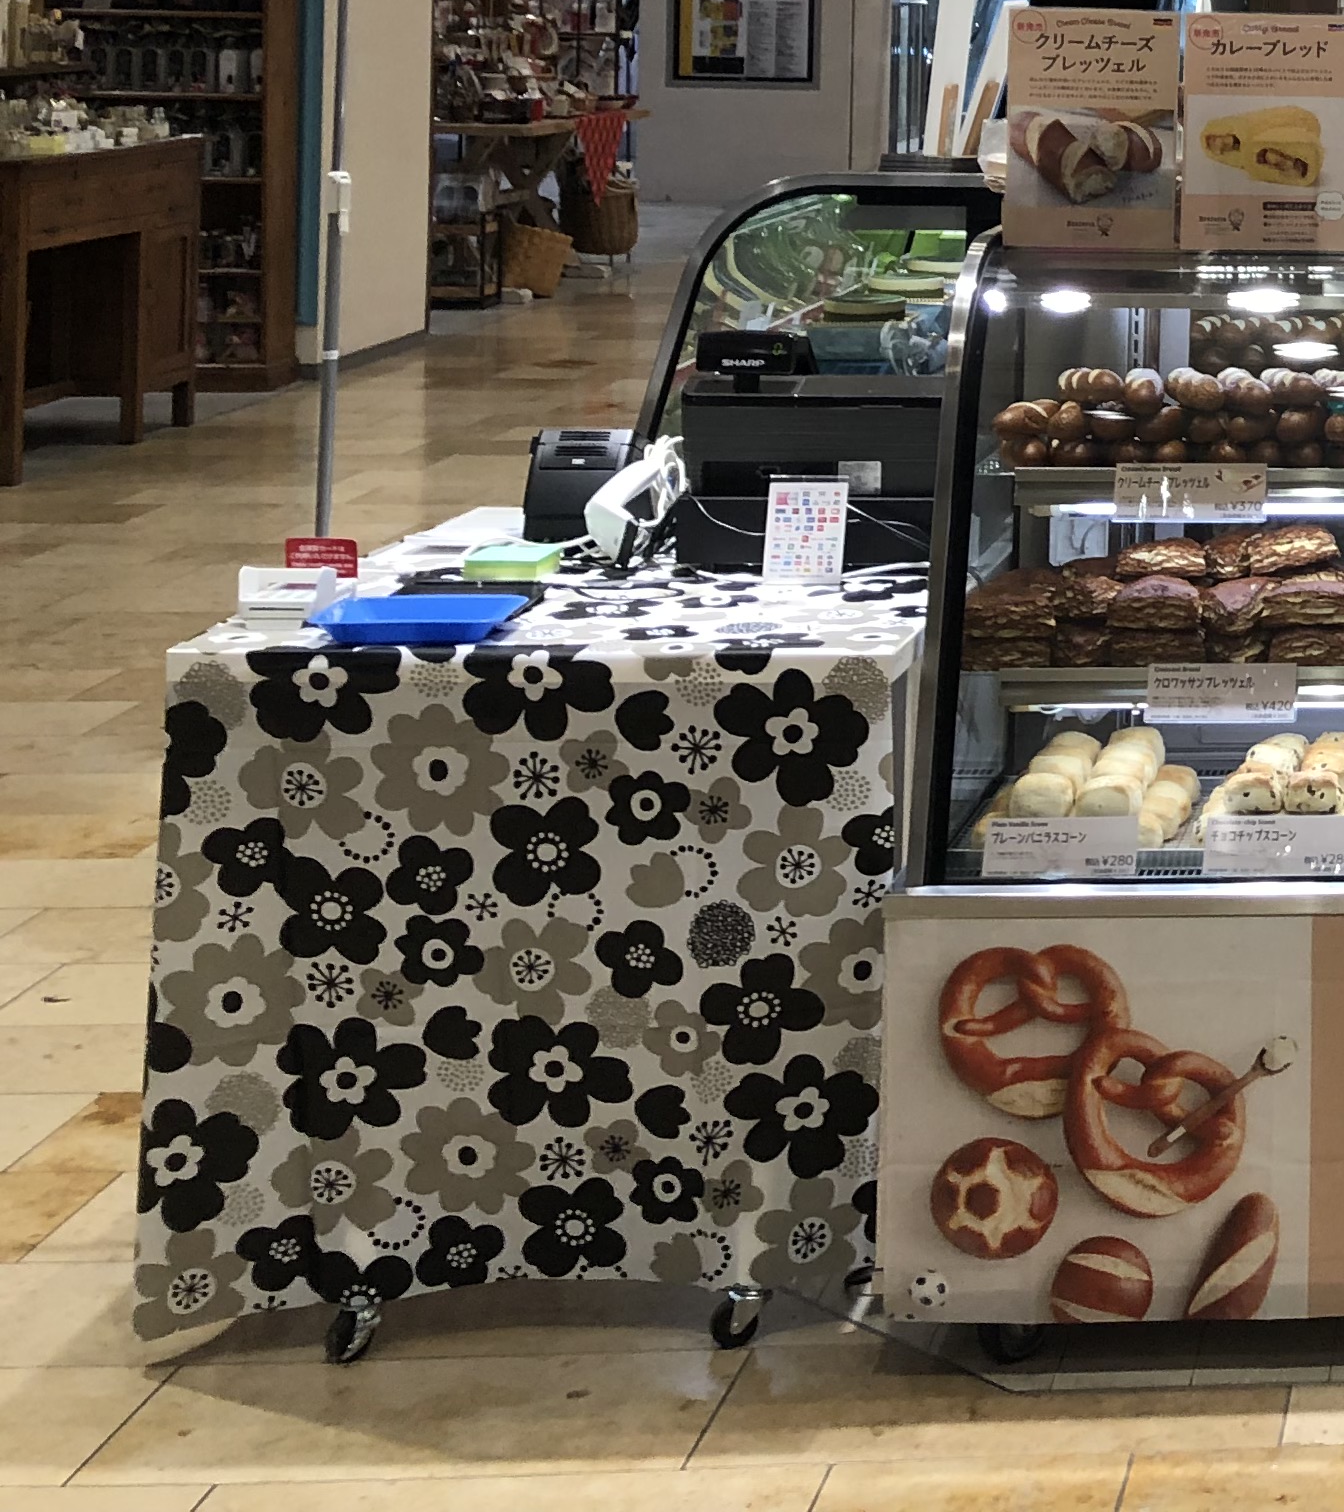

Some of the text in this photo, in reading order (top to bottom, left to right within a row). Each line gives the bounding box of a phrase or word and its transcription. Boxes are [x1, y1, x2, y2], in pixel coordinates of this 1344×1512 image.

[1035, 33, 1155, 52] クリームチーズ
[1210, 39, 1328, 58] カレーブレッド
[1231, 501, 1262, 511] ¥370
[1261, 700, 1292, 711] ¥420
[1102, 855, 1134, 866] ¥280
